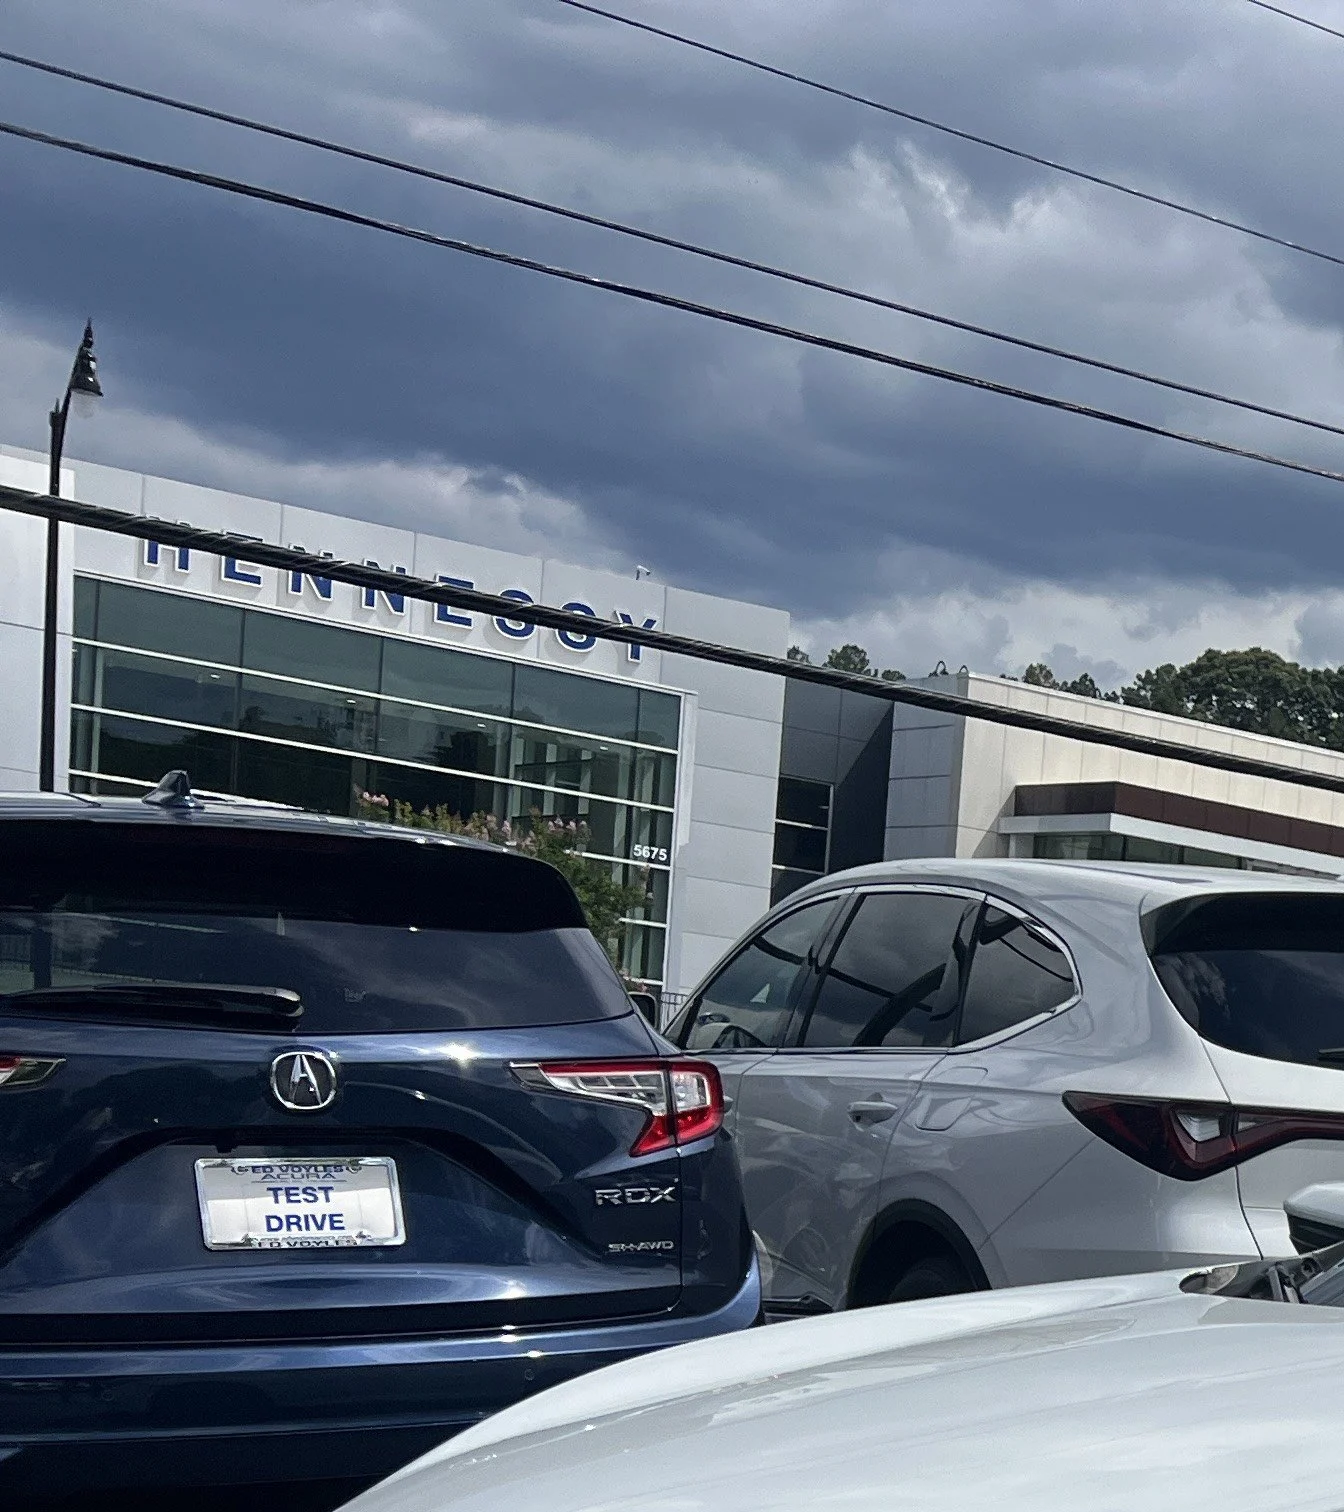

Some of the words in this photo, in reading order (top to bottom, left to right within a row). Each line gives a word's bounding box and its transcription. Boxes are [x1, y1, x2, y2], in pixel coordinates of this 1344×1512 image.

[633, 844, 667, 861] 5675
[261, 1172, 336, 1180] ACURA
[267, 1186, 334, 1204] TEST
[595, 1187, 676, 1205] RDX
[265, 1213, 345, 1232] DRIVE
